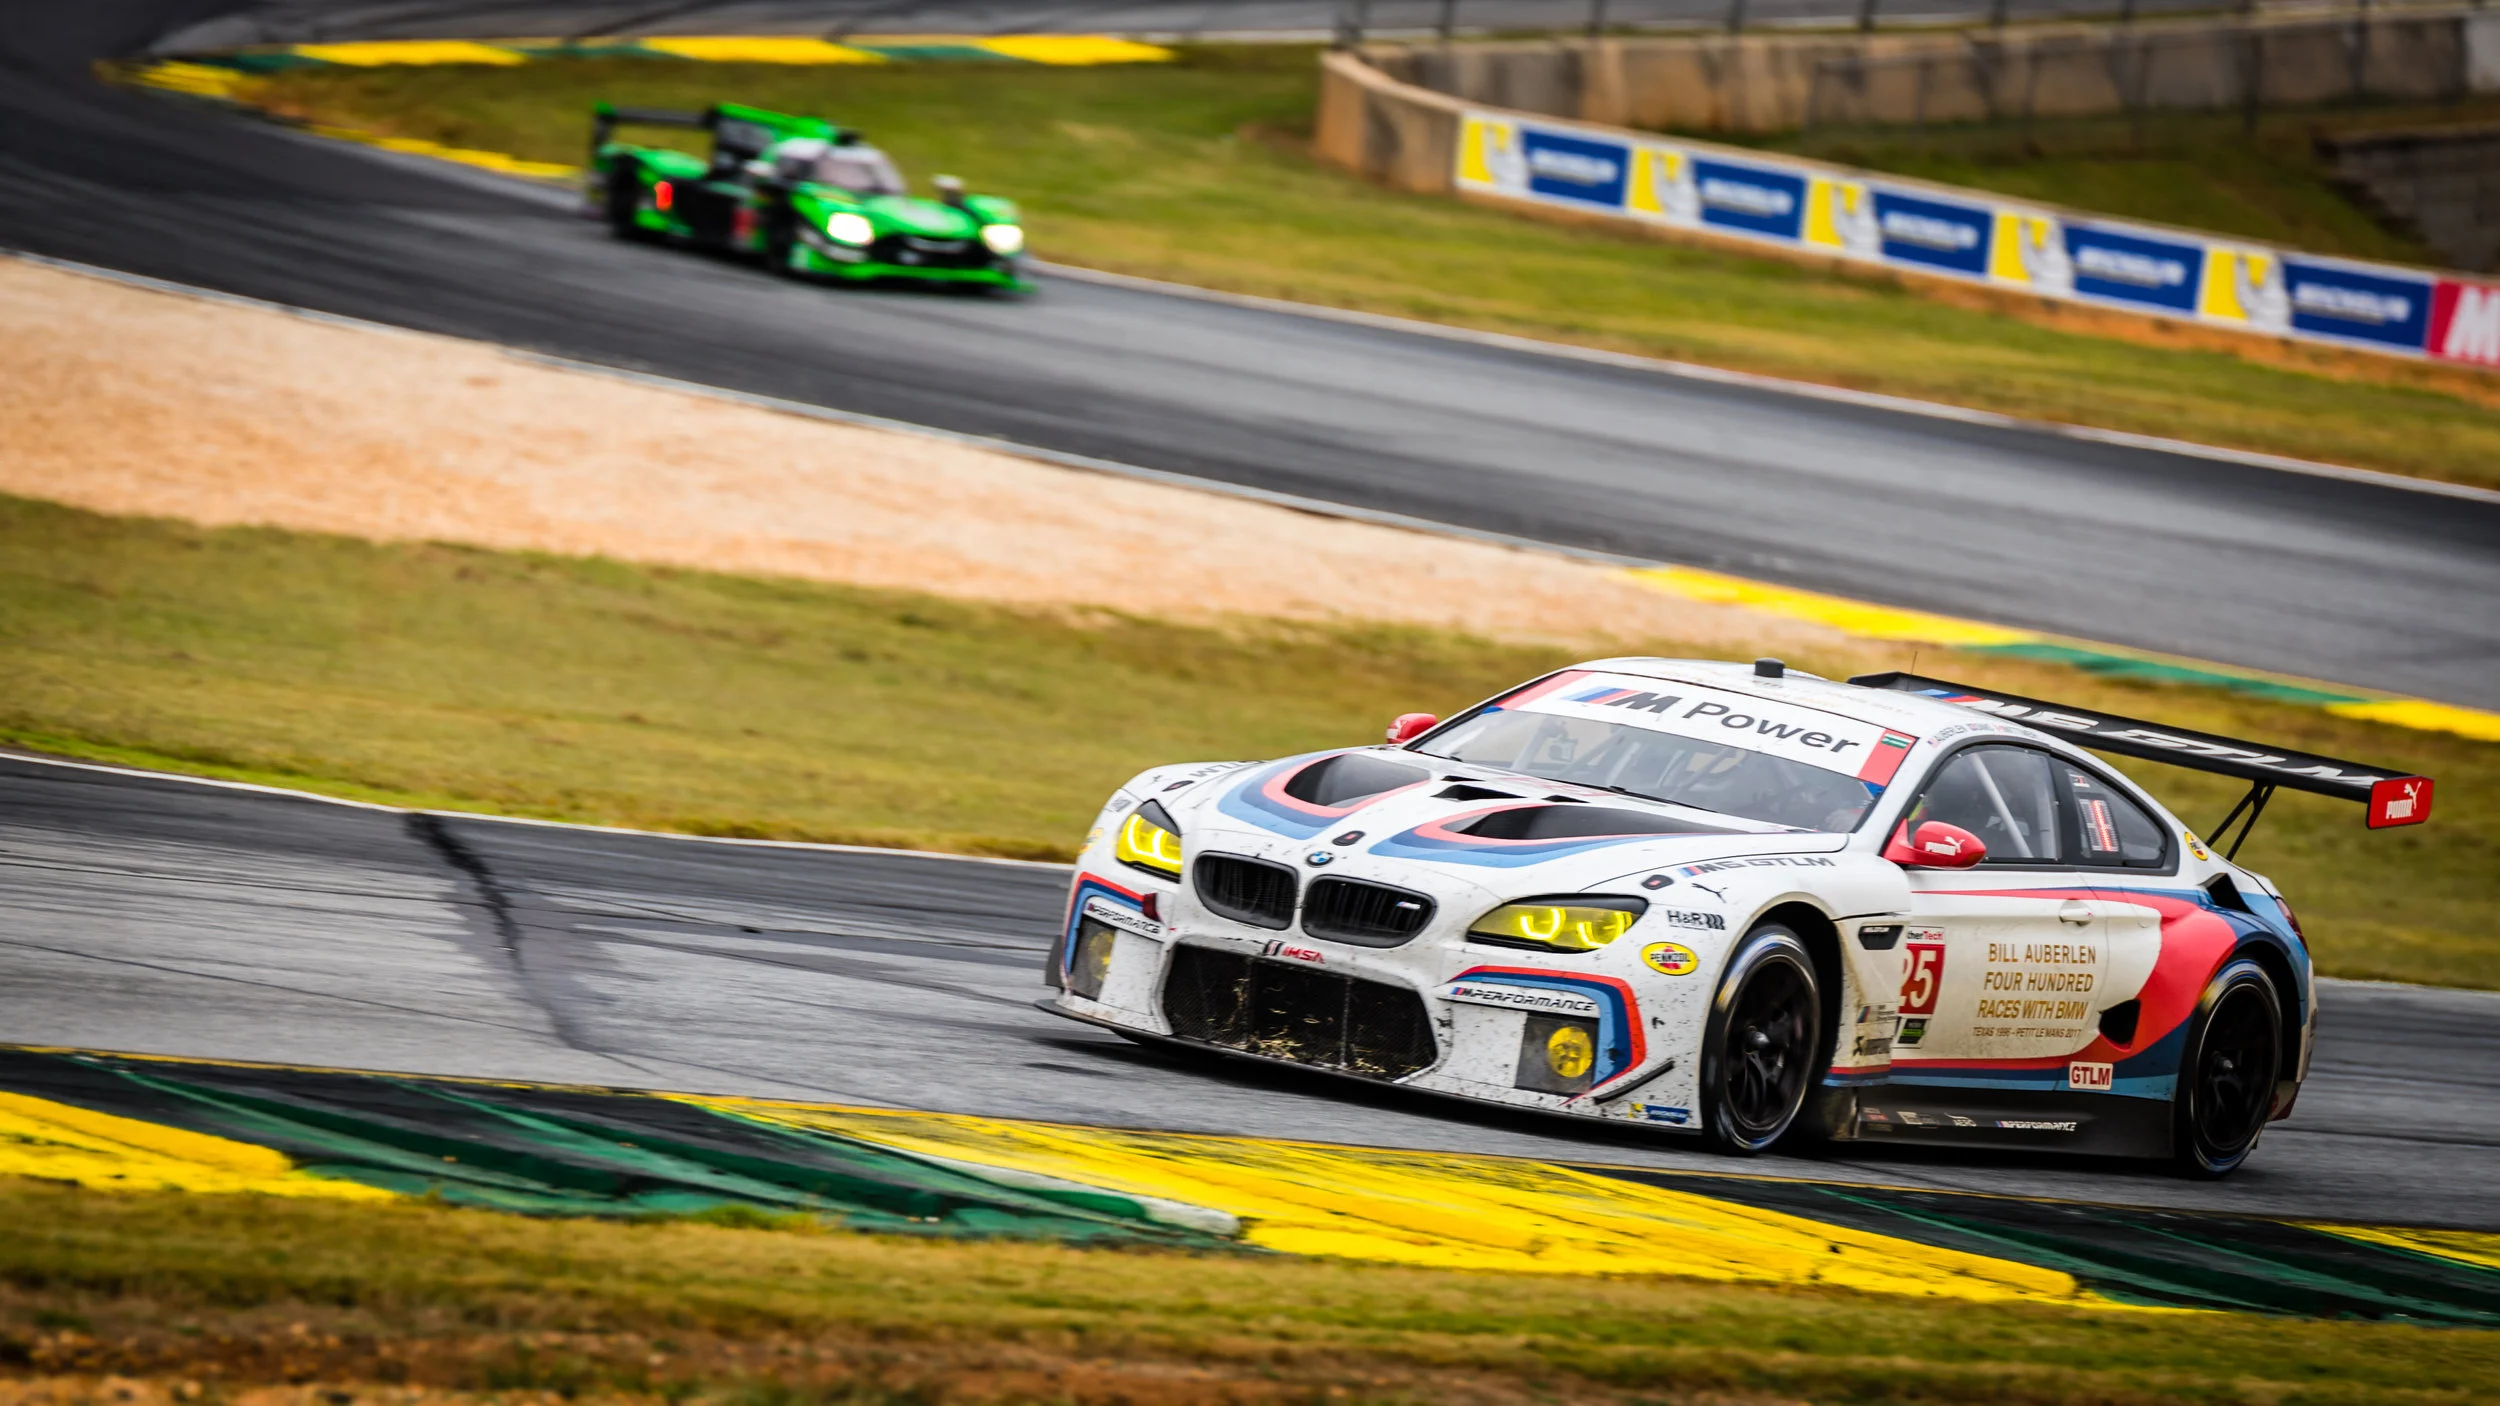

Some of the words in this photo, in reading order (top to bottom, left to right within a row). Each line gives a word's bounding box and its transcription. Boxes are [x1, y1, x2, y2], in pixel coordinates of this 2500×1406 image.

[1603, 692, 1683, 713] M
[1682, 701, 1860, 753] Power
[2385, 799, 2413, 820] PUMA
[1745, 857, 1836, 867] GTLM
[1666, 909, 1704, 926] H&R
[1988, 943, 2019, 962] BILL
[2024, 943, 2097, 964] AUBERLEN
[1983, 971, 2023, 991] FOUR
[2026, 972, 2094, 992] HUNDRED
[1977, 999, 2021, 1019] RACES
[2022, 1000, 2055, 1019] WITH
[2055, 1000, 2089, 1020] BMW
[1973, 1026, 1995, 1037] TEXAS
[2016, 1027, 2036, 1037] PETIT
[2035, 1028, 2045, 1038] LE
[2046, 1028, 2065, 1038] MANS
[2071, 1065, 2111, 1086] GTLM
